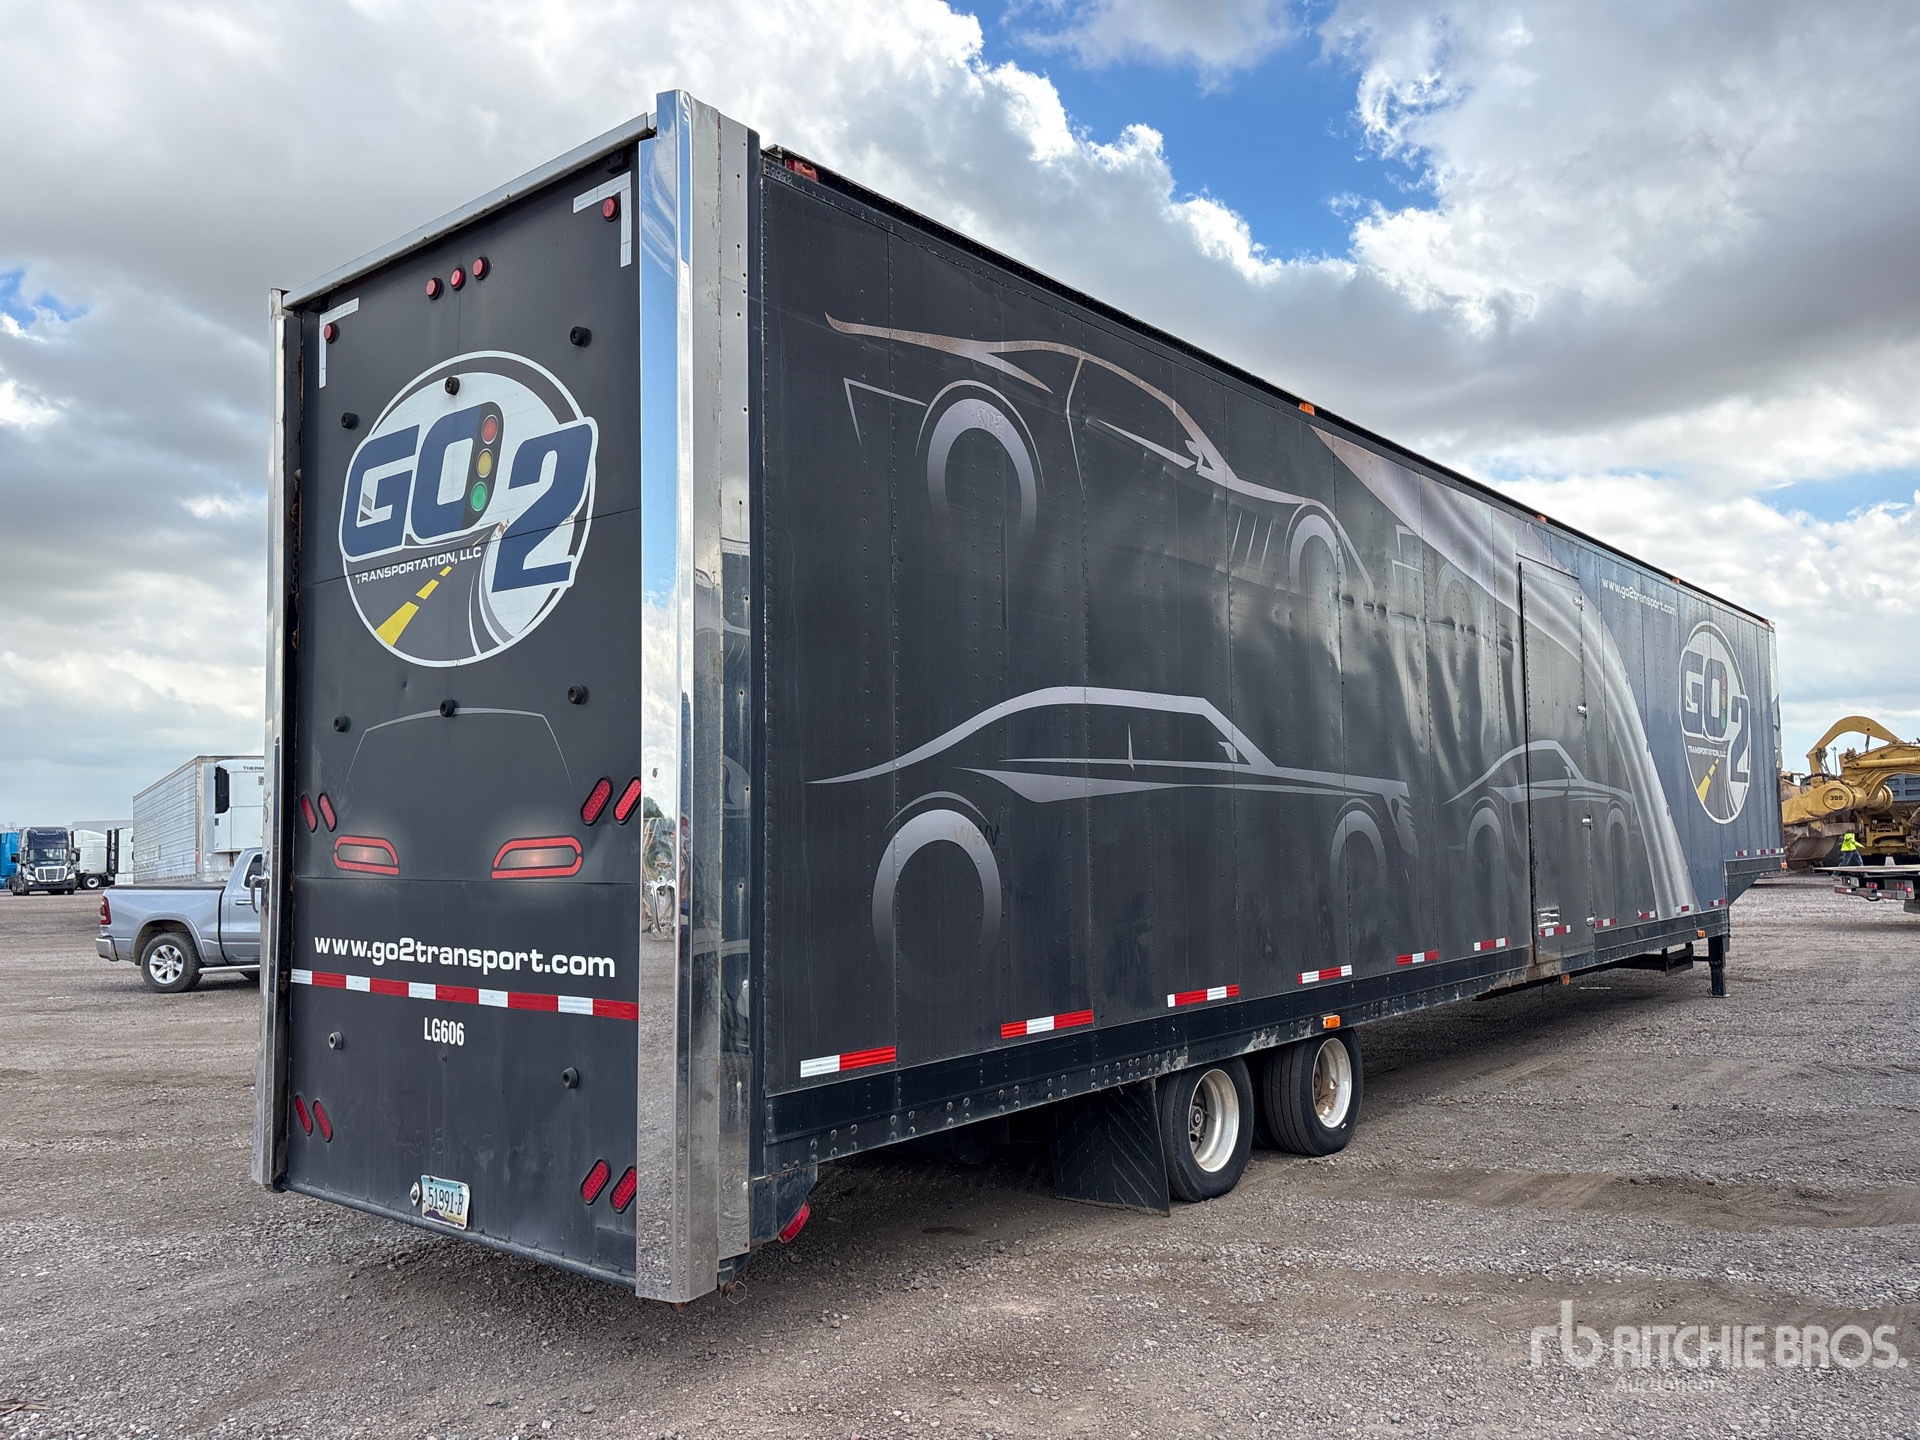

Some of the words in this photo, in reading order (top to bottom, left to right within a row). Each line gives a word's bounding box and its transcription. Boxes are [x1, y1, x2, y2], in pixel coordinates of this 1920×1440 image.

[355, 551, 458, 584] TRANSPORTATION,
[460, 547, 482, 561] LLC
[1601, 578, 1677, 617] www.go2transport.com
[314, 936, 616, 978] www.go2transport.com
[423, 1017, 465, 1047] LG606
